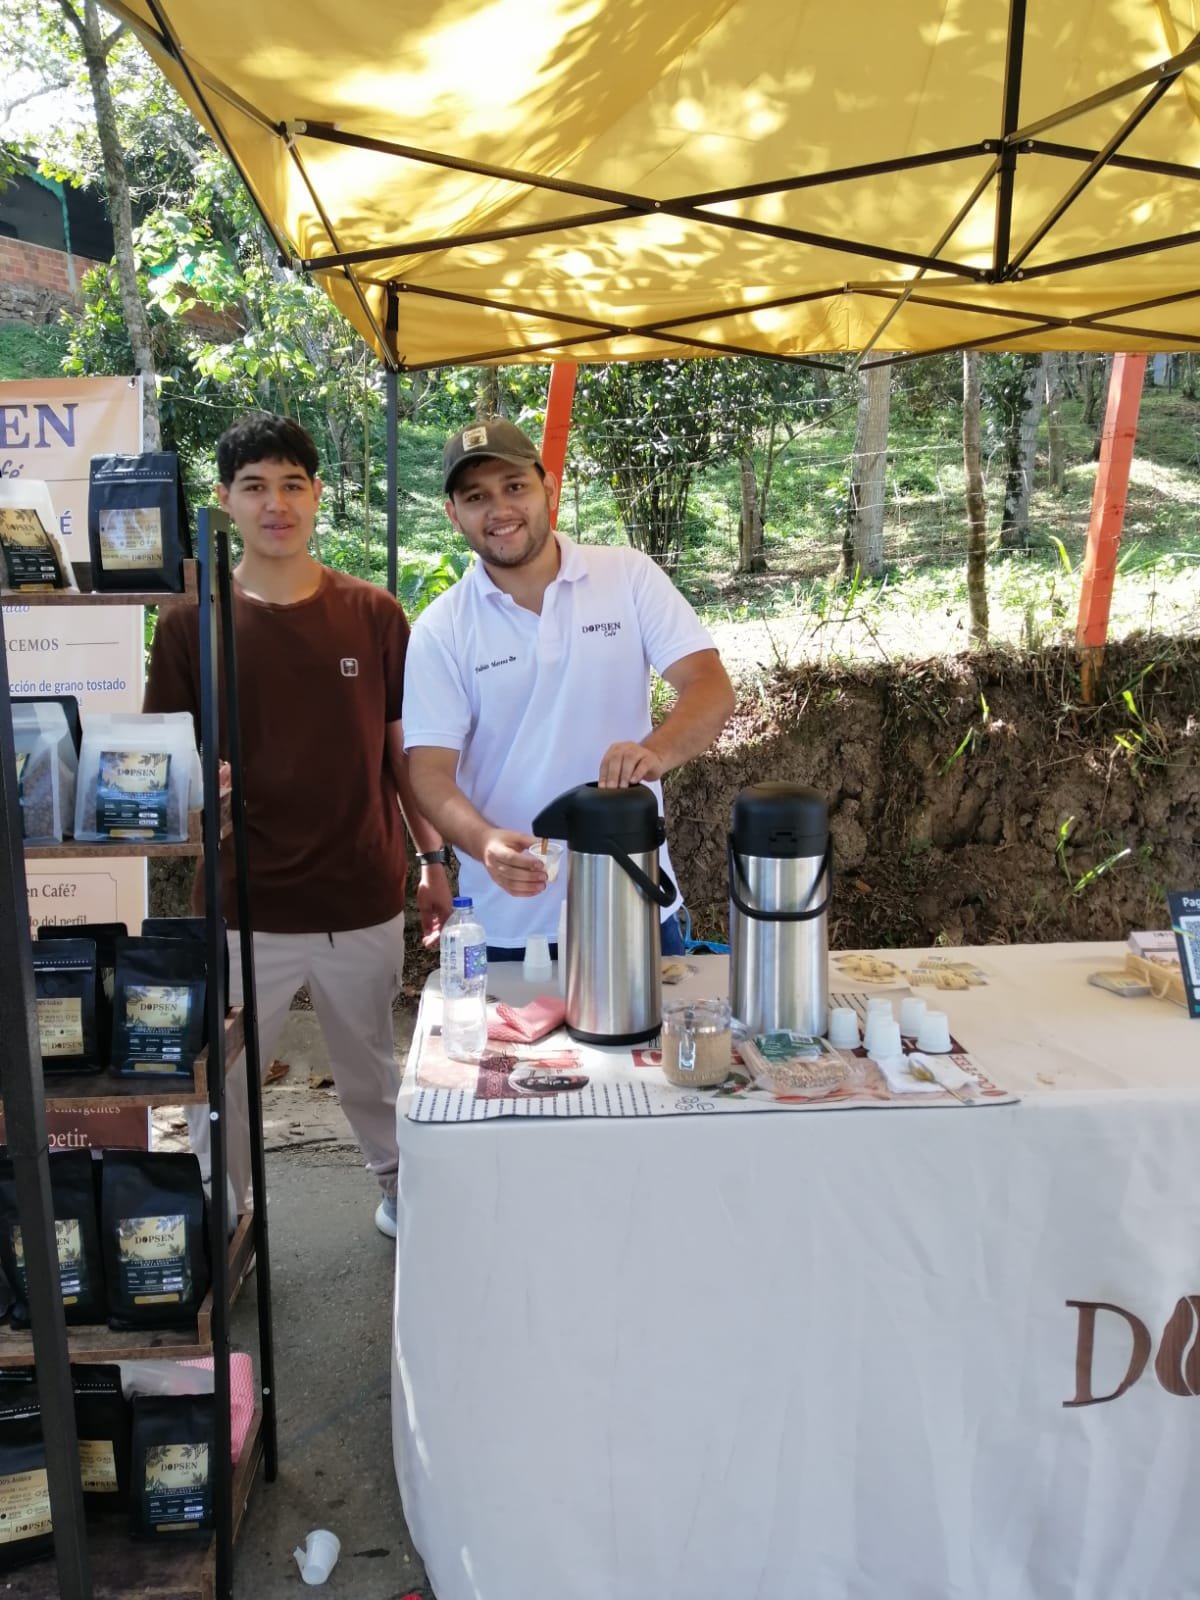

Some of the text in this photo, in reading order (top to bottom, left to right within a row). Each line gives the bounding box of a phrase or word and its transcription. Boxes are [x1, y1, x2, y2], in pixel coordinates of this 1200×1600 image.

[582, 621, 621, 633] DOPSEN
[39, 679, 52, 692] de
[54, 683, 84, 694] grano
[86, 677, 126, 691] tostado
[117, 768, 156, 777] DOPSEN
[42, 883, 77, 898] Café?
[139, 1002, 178, 1012] DOPSEN
[135, 1232, 175, 1245] DOPSEN
[161, 1461, 198, 1472] DOPSEN
